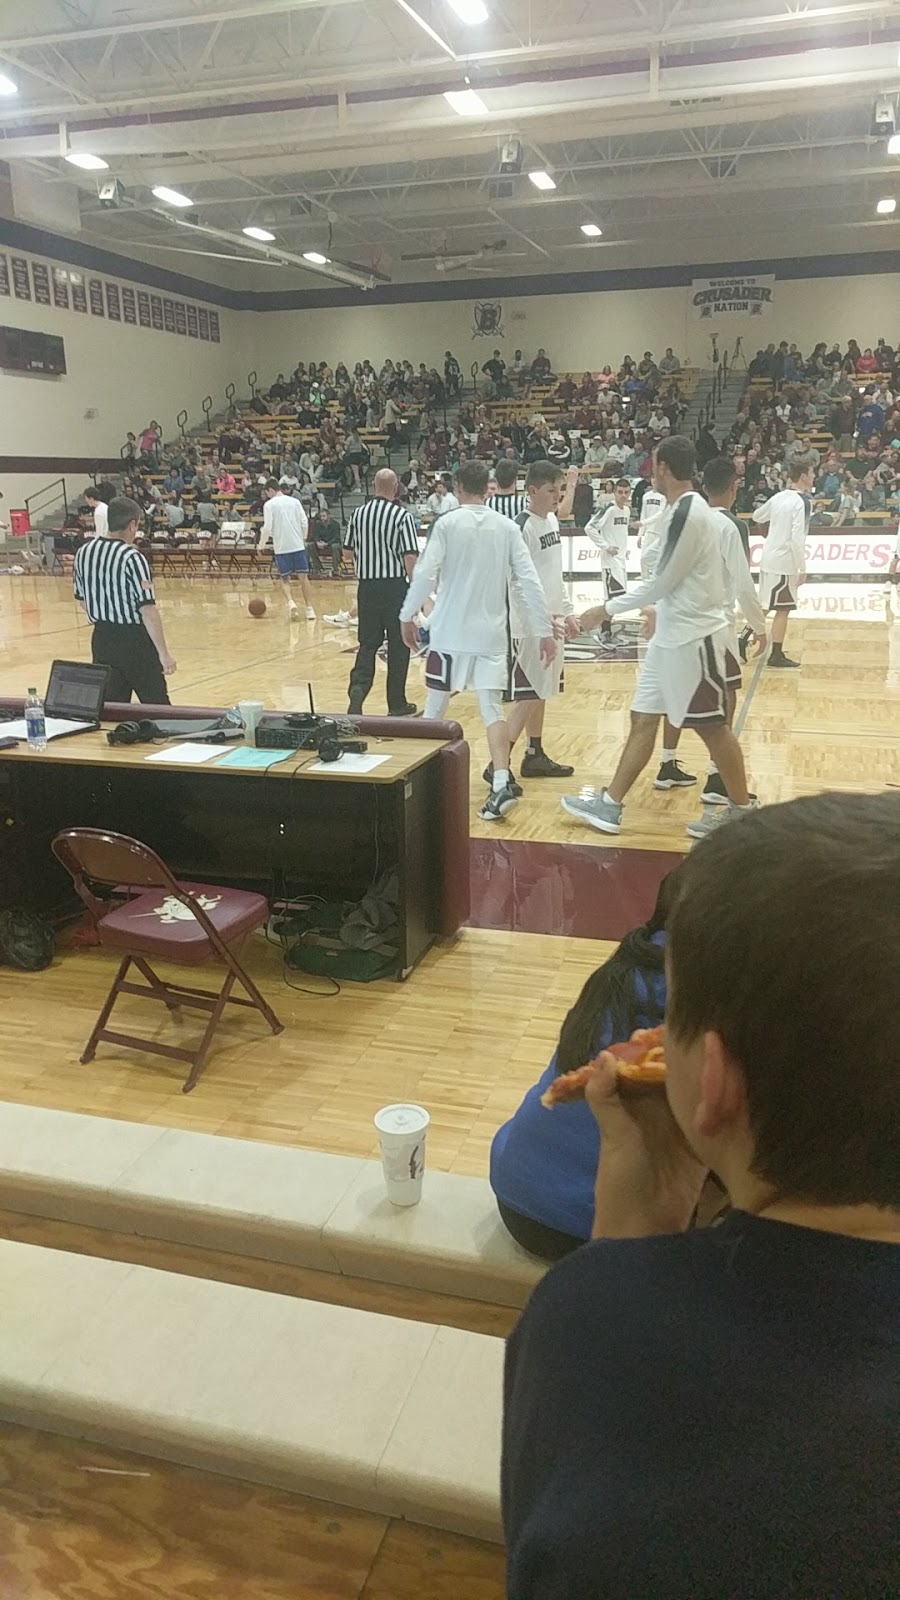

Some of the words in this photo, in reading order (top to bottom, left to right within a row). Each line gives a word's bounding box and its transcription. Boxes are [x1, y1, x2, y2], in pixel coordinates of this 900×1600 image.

[709, 279, 745, 287] WELCOME
[693, 286, 772, 306] CRUSADER
[713, 301, 749, 312] NATION
